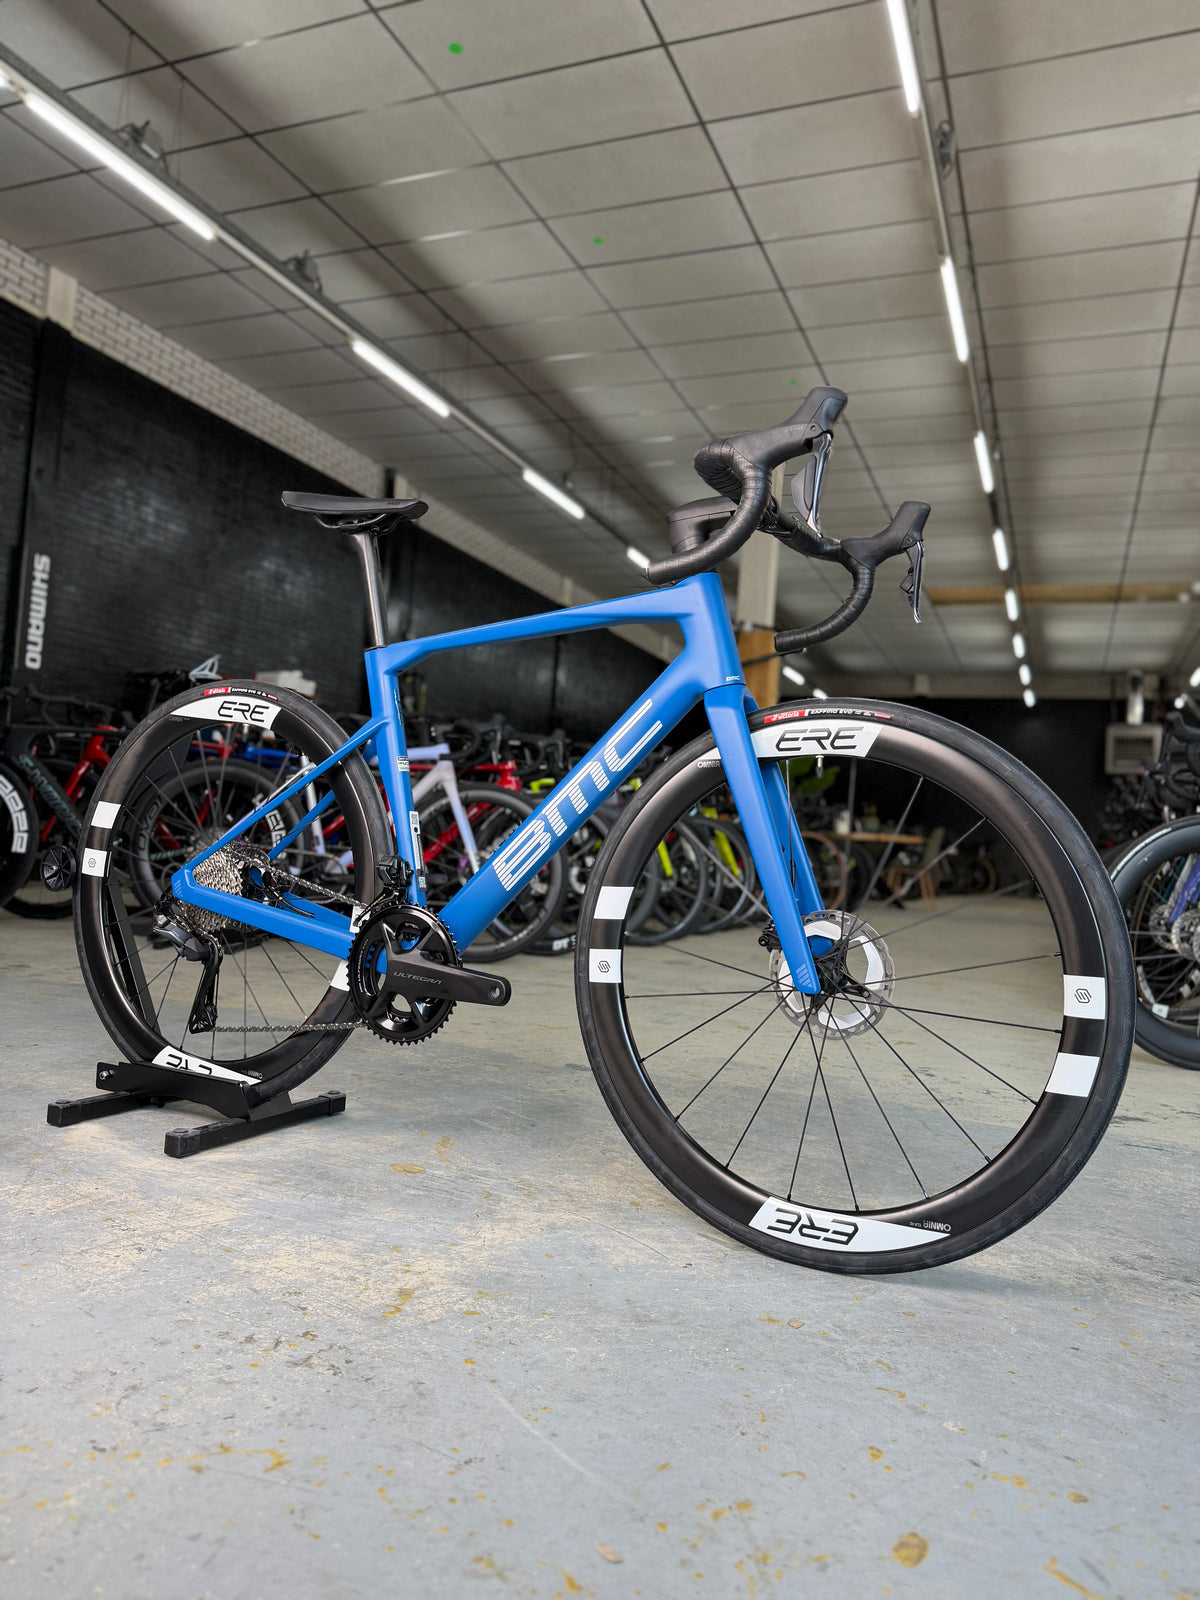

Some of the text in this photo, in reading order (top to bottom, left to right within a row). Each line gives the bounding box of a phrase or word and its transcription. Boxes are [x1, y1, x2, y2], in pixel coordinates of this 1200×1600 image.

[25, 552, 51, 670] SHIMANO
[217, 700, 270, 722] ERE
[775, 726, 864, 752] ERE
[492, 698, 663, 892] BMC
[552, 937, 570, 951] DT
[393, 971, 442, 985] ULTEGRA
[766, 1207, 859, 1246] ERE
[922, 1219, 951, 1232] OMNIA
